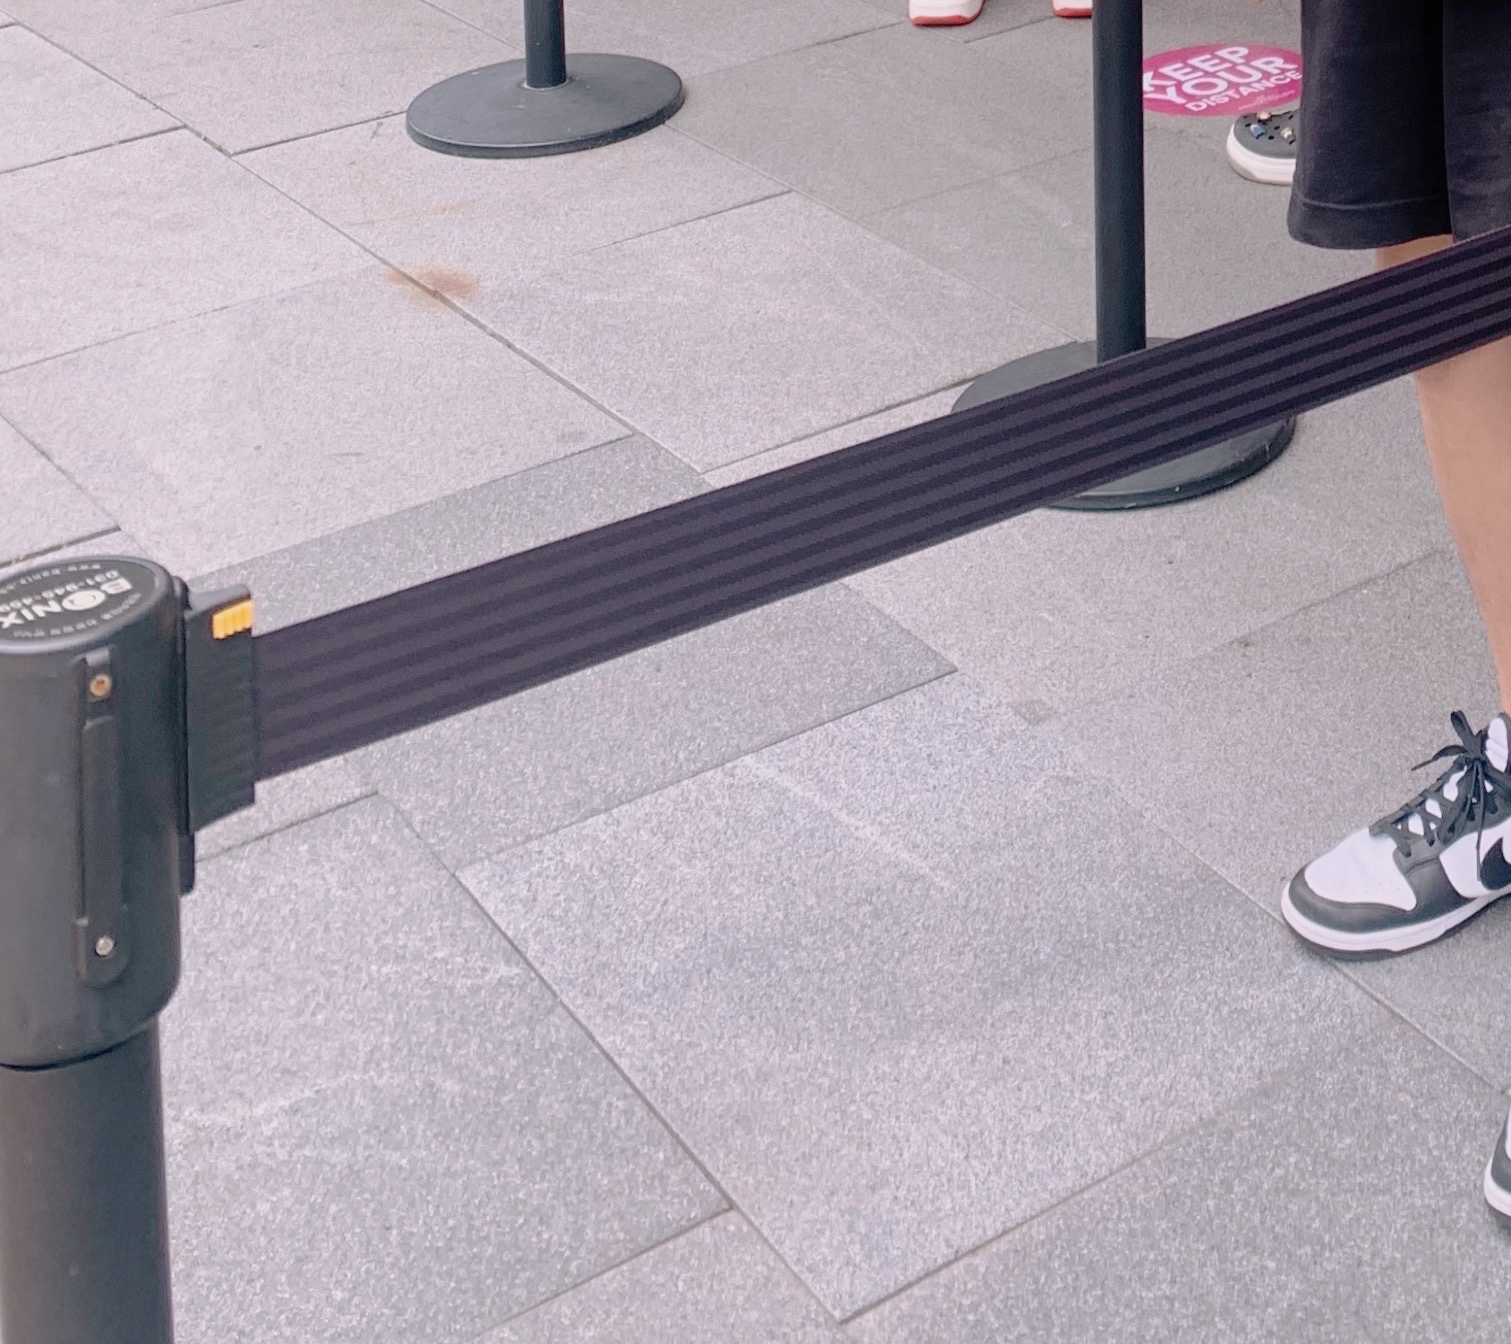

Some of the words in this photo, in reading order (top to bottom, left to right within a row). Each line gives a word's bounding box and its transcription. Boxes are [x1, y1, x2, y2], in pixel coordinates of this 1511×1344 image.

[1143, 47, 1249, 93] KEEP
[1143, 57, 1298, 105] YOUR
[1185, 70, 1302, 112] DISTANCE
[0, 577, 133, 629] BONIX
